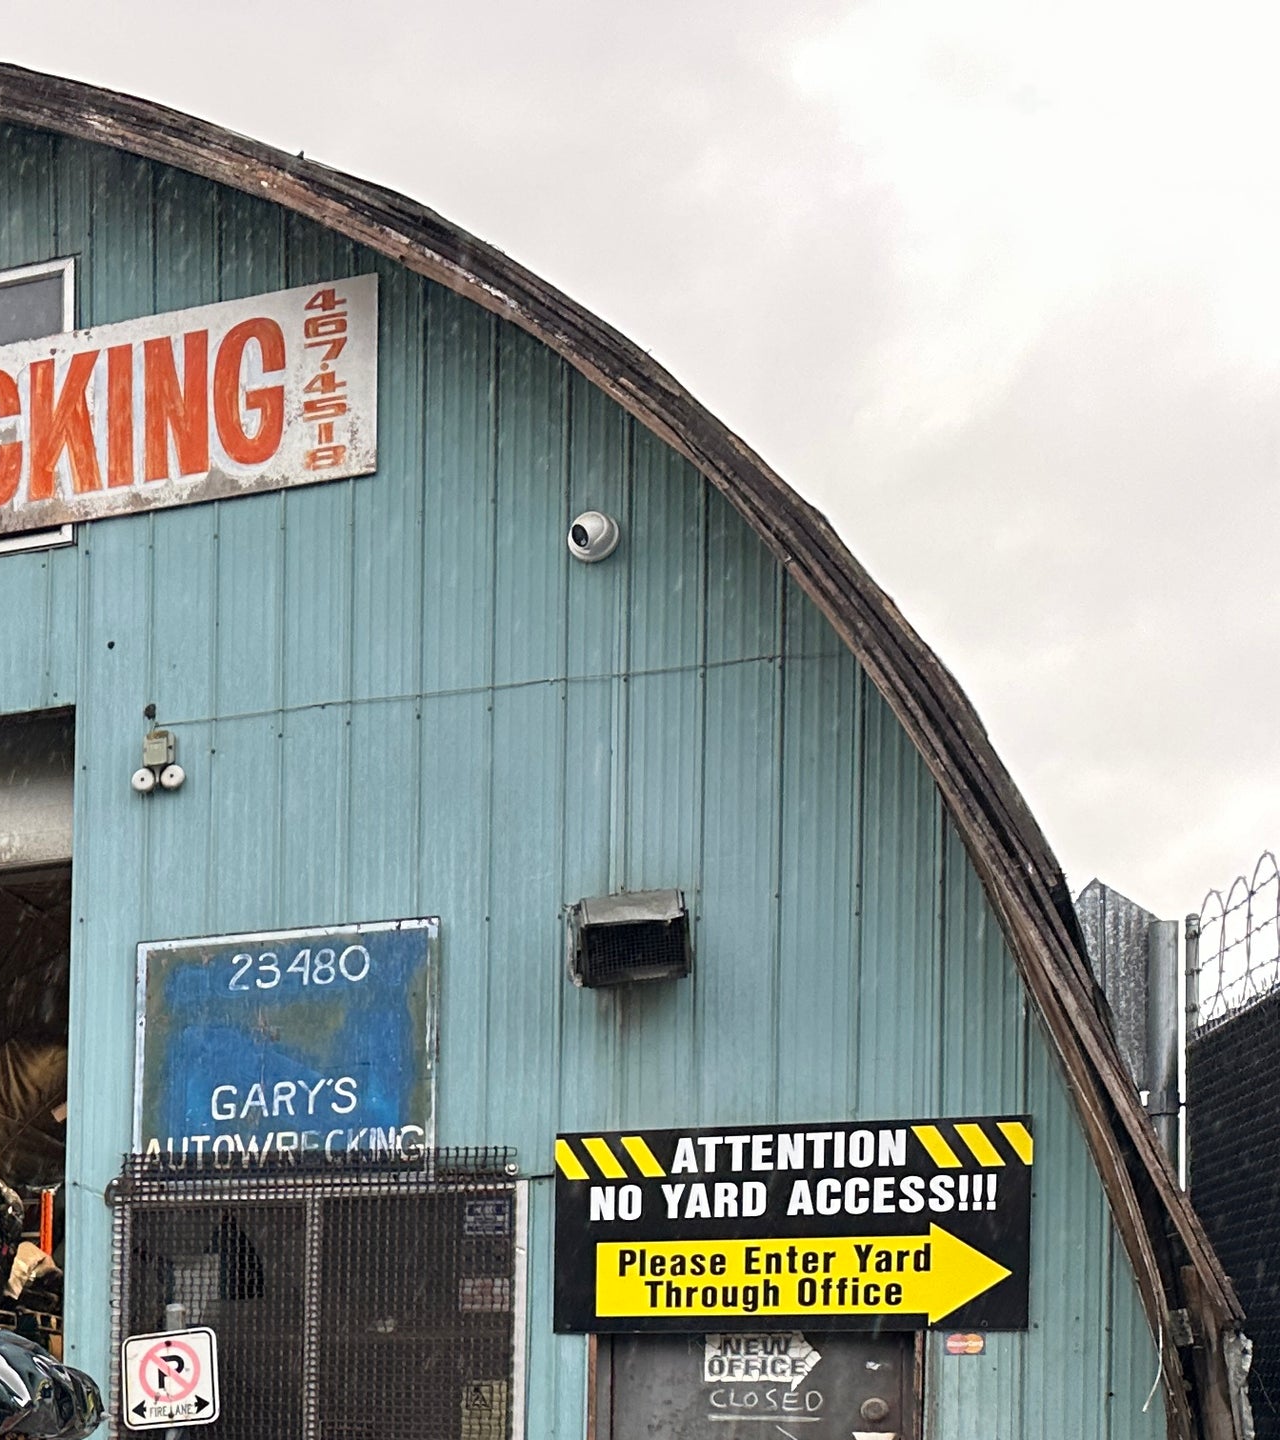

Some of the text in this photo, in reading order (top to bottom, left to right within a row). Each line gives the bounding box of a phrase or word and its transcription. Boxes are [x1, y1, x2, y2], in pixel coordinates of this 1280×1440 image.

[228, 944, 371, 992] 23480
[210, 1076, 358, 1122] GARY'S
[670, 1129, 907, 1175] ATTENTION
[589, 1173, 998, 1222] NO YARD ACCESS!!!
[618, 1242, 932, 1278] Please Enter Yard
[644, 1276, 904, 1314] Through Office
[723, 1334, 792, 1355] NEW
[708, 1355, 807, 1377] OFFICE
[149, 1403, 195, 1418] FIRE LANE
[710, 1388, 824, 1412] CLOSED
